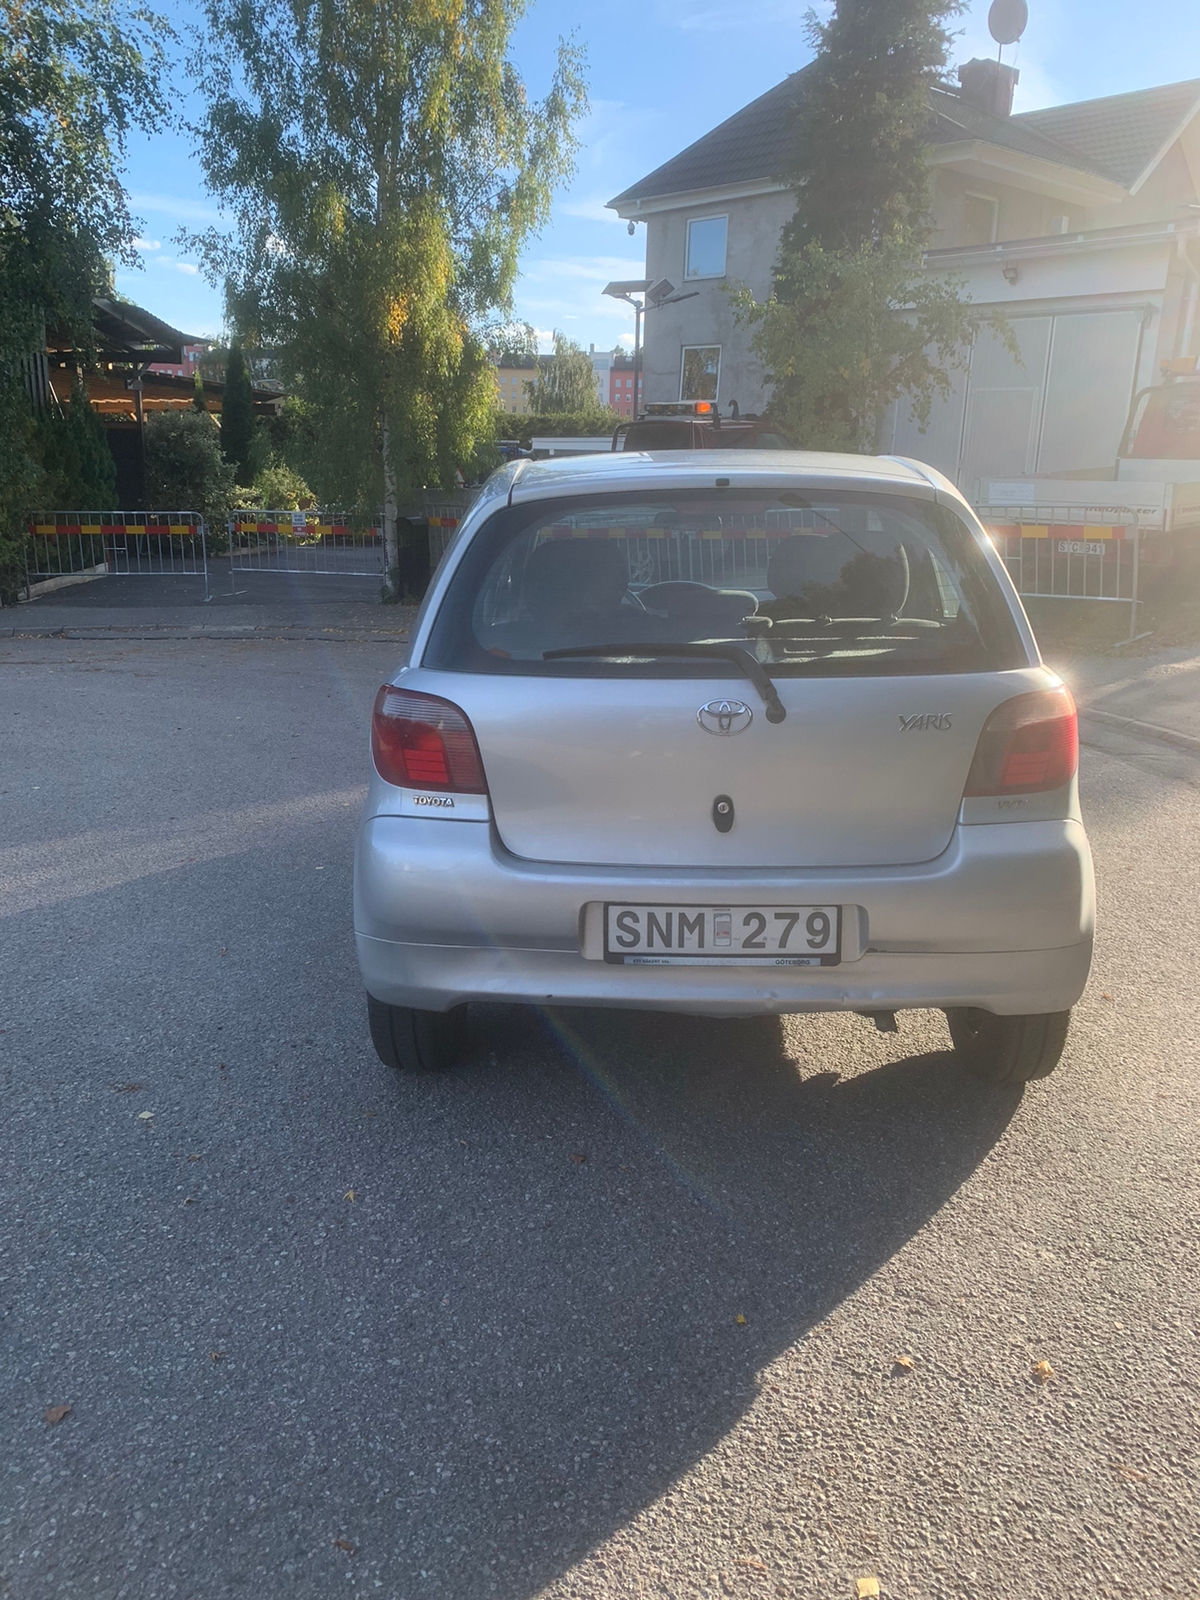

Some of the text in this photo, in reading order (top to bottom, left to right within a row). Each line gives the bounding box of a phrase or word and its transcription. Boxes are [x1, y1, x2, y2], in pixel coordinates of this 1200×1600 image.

[1059, 541, 1079, 552] SC
[413, 795, 455, 808] TOYOTA
[615, 910, 831, 949] SNM 279
[775, 957, 811, 966] GÖTEBORG
